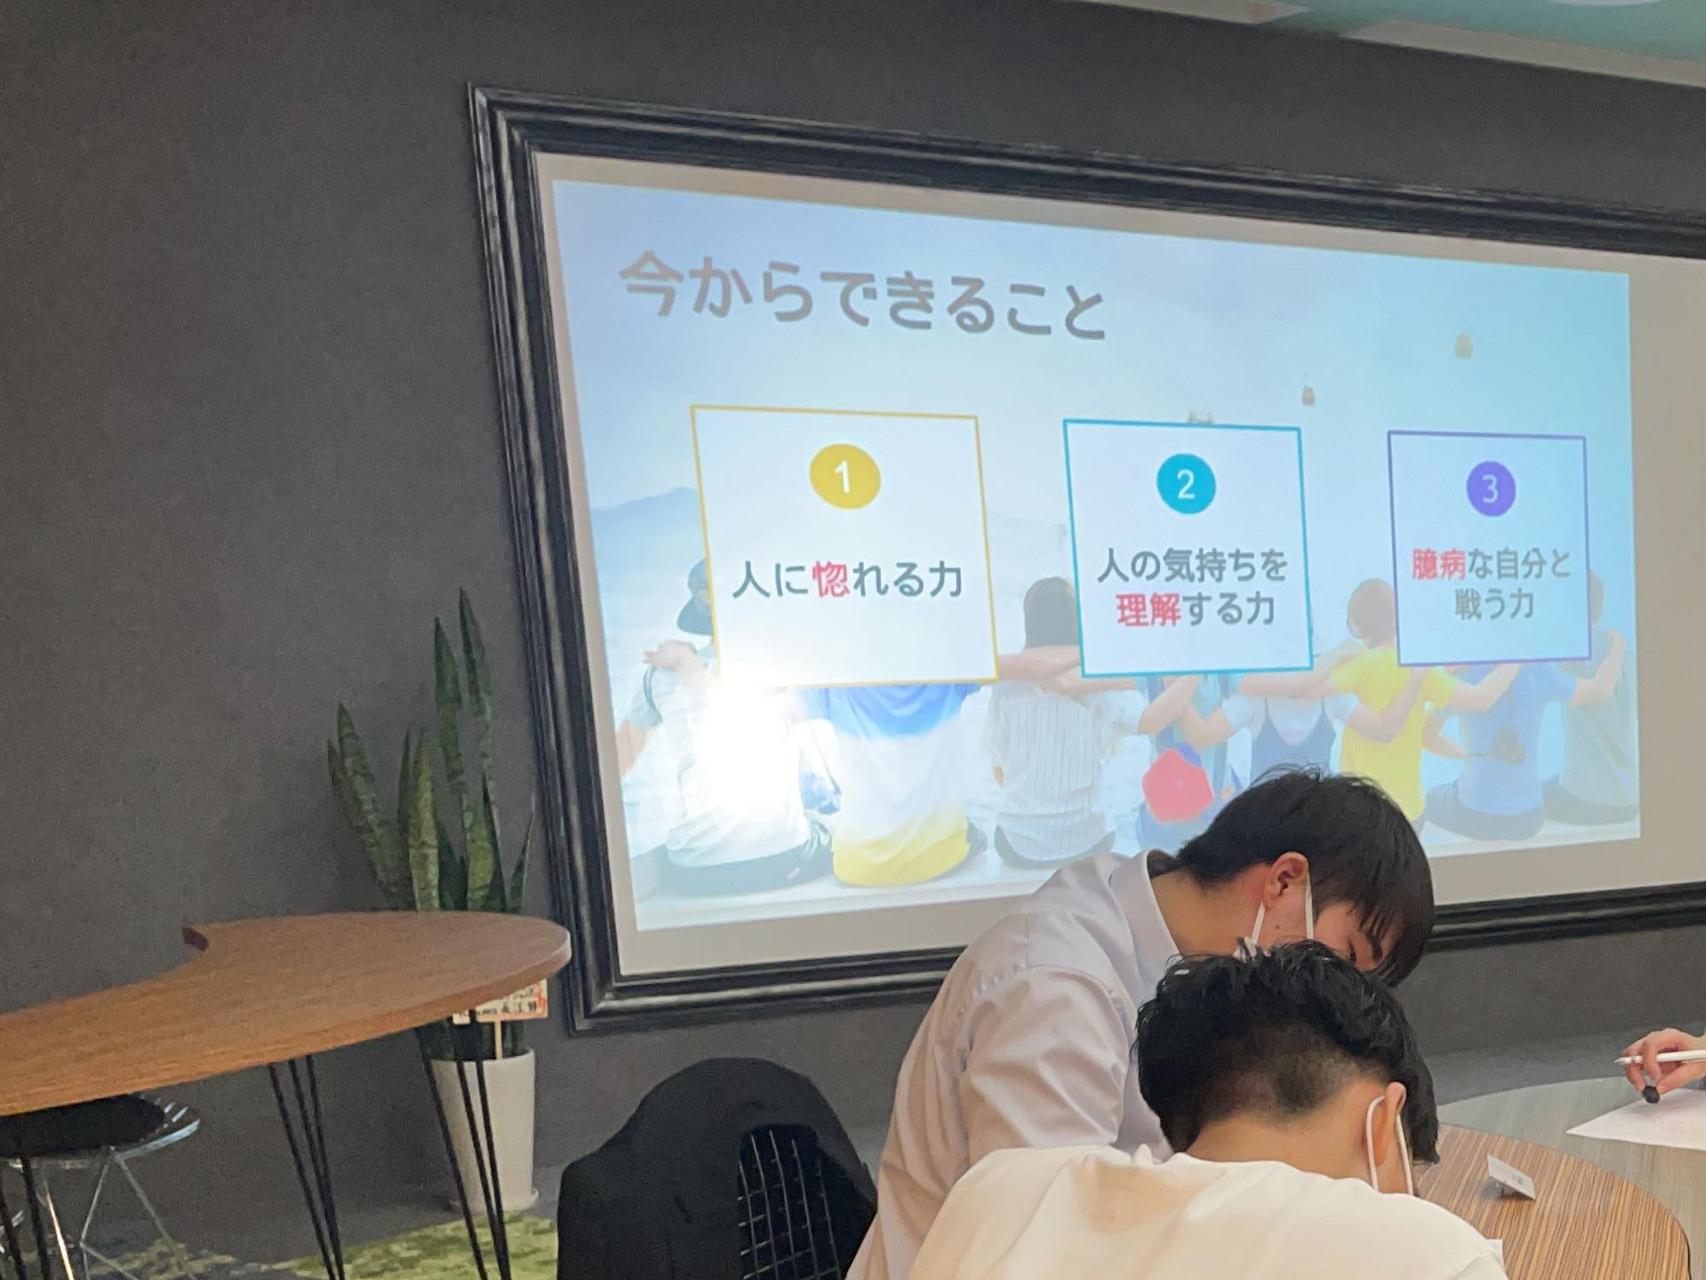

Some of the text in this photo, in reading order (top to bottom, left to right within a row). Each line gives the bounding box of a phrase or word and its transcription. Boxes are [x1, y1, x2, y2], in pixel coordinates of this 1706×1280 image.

[618, 249, 1106, 340] 今からできること
[834, 460, 850, 494] 1
[1176, 469, 1196, 500] 2
[1482, 474, 1500, 504] 3
[732, 560, 963, 599] 人に惚れる力
[1097, 547, 1288, 583] 人の気持ちを
[1412, 547, 1571, 581] 臆病な自分と
[1115, 591, 1276, 627] 理解する力
[1454, 587, 1535, 621] 戦う力
